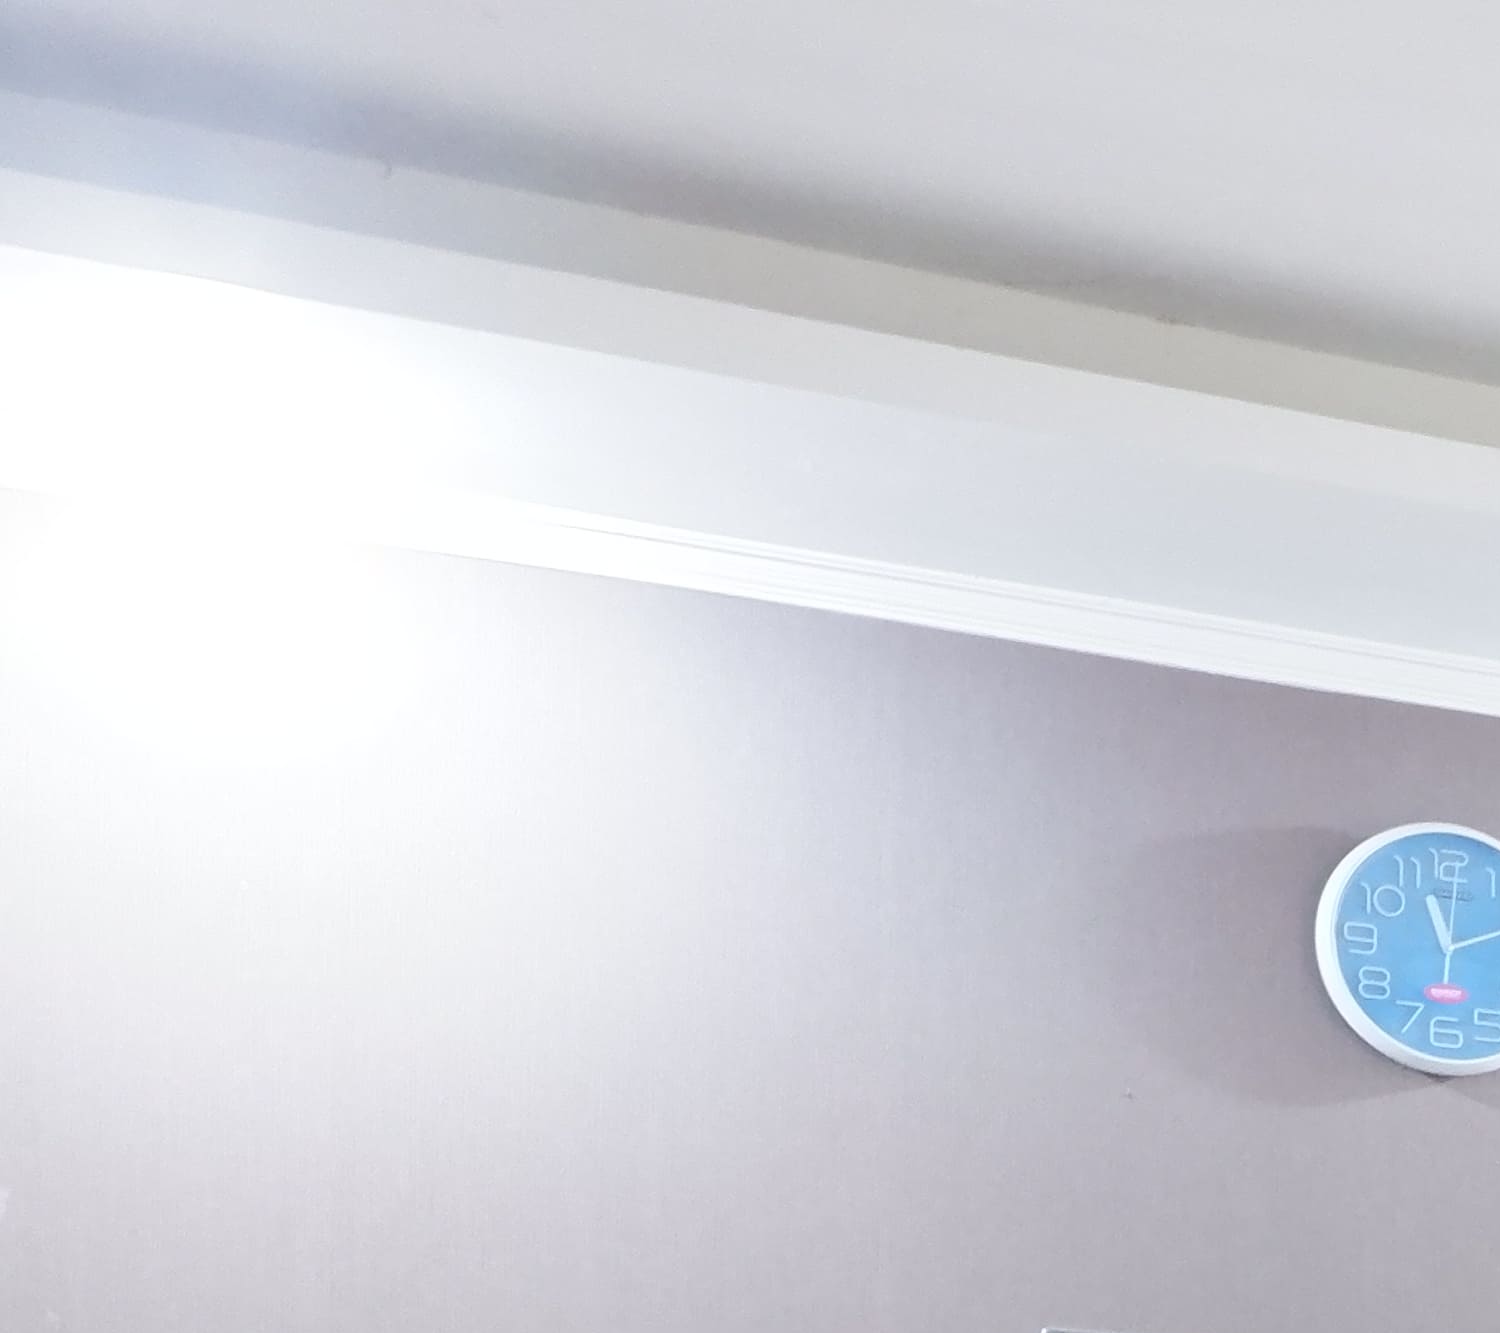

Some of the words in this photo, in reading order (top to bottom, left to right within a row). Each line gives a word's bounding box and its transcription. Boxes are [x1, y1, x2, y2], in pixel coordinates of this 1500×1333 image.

[1394, 854, 1422, 888] 11
[1429, 848, 1469, 883] 12
[1485, 867, 1497, 898] 1
[1360, 882, 1405, 917] 10
[1343, 921, 1378, 955] 9
[1358, 965, 1390, 1000] 8
[1395, 1000, 1425, 1033] 7
[1429, 1015, 1464, 1049] 6
